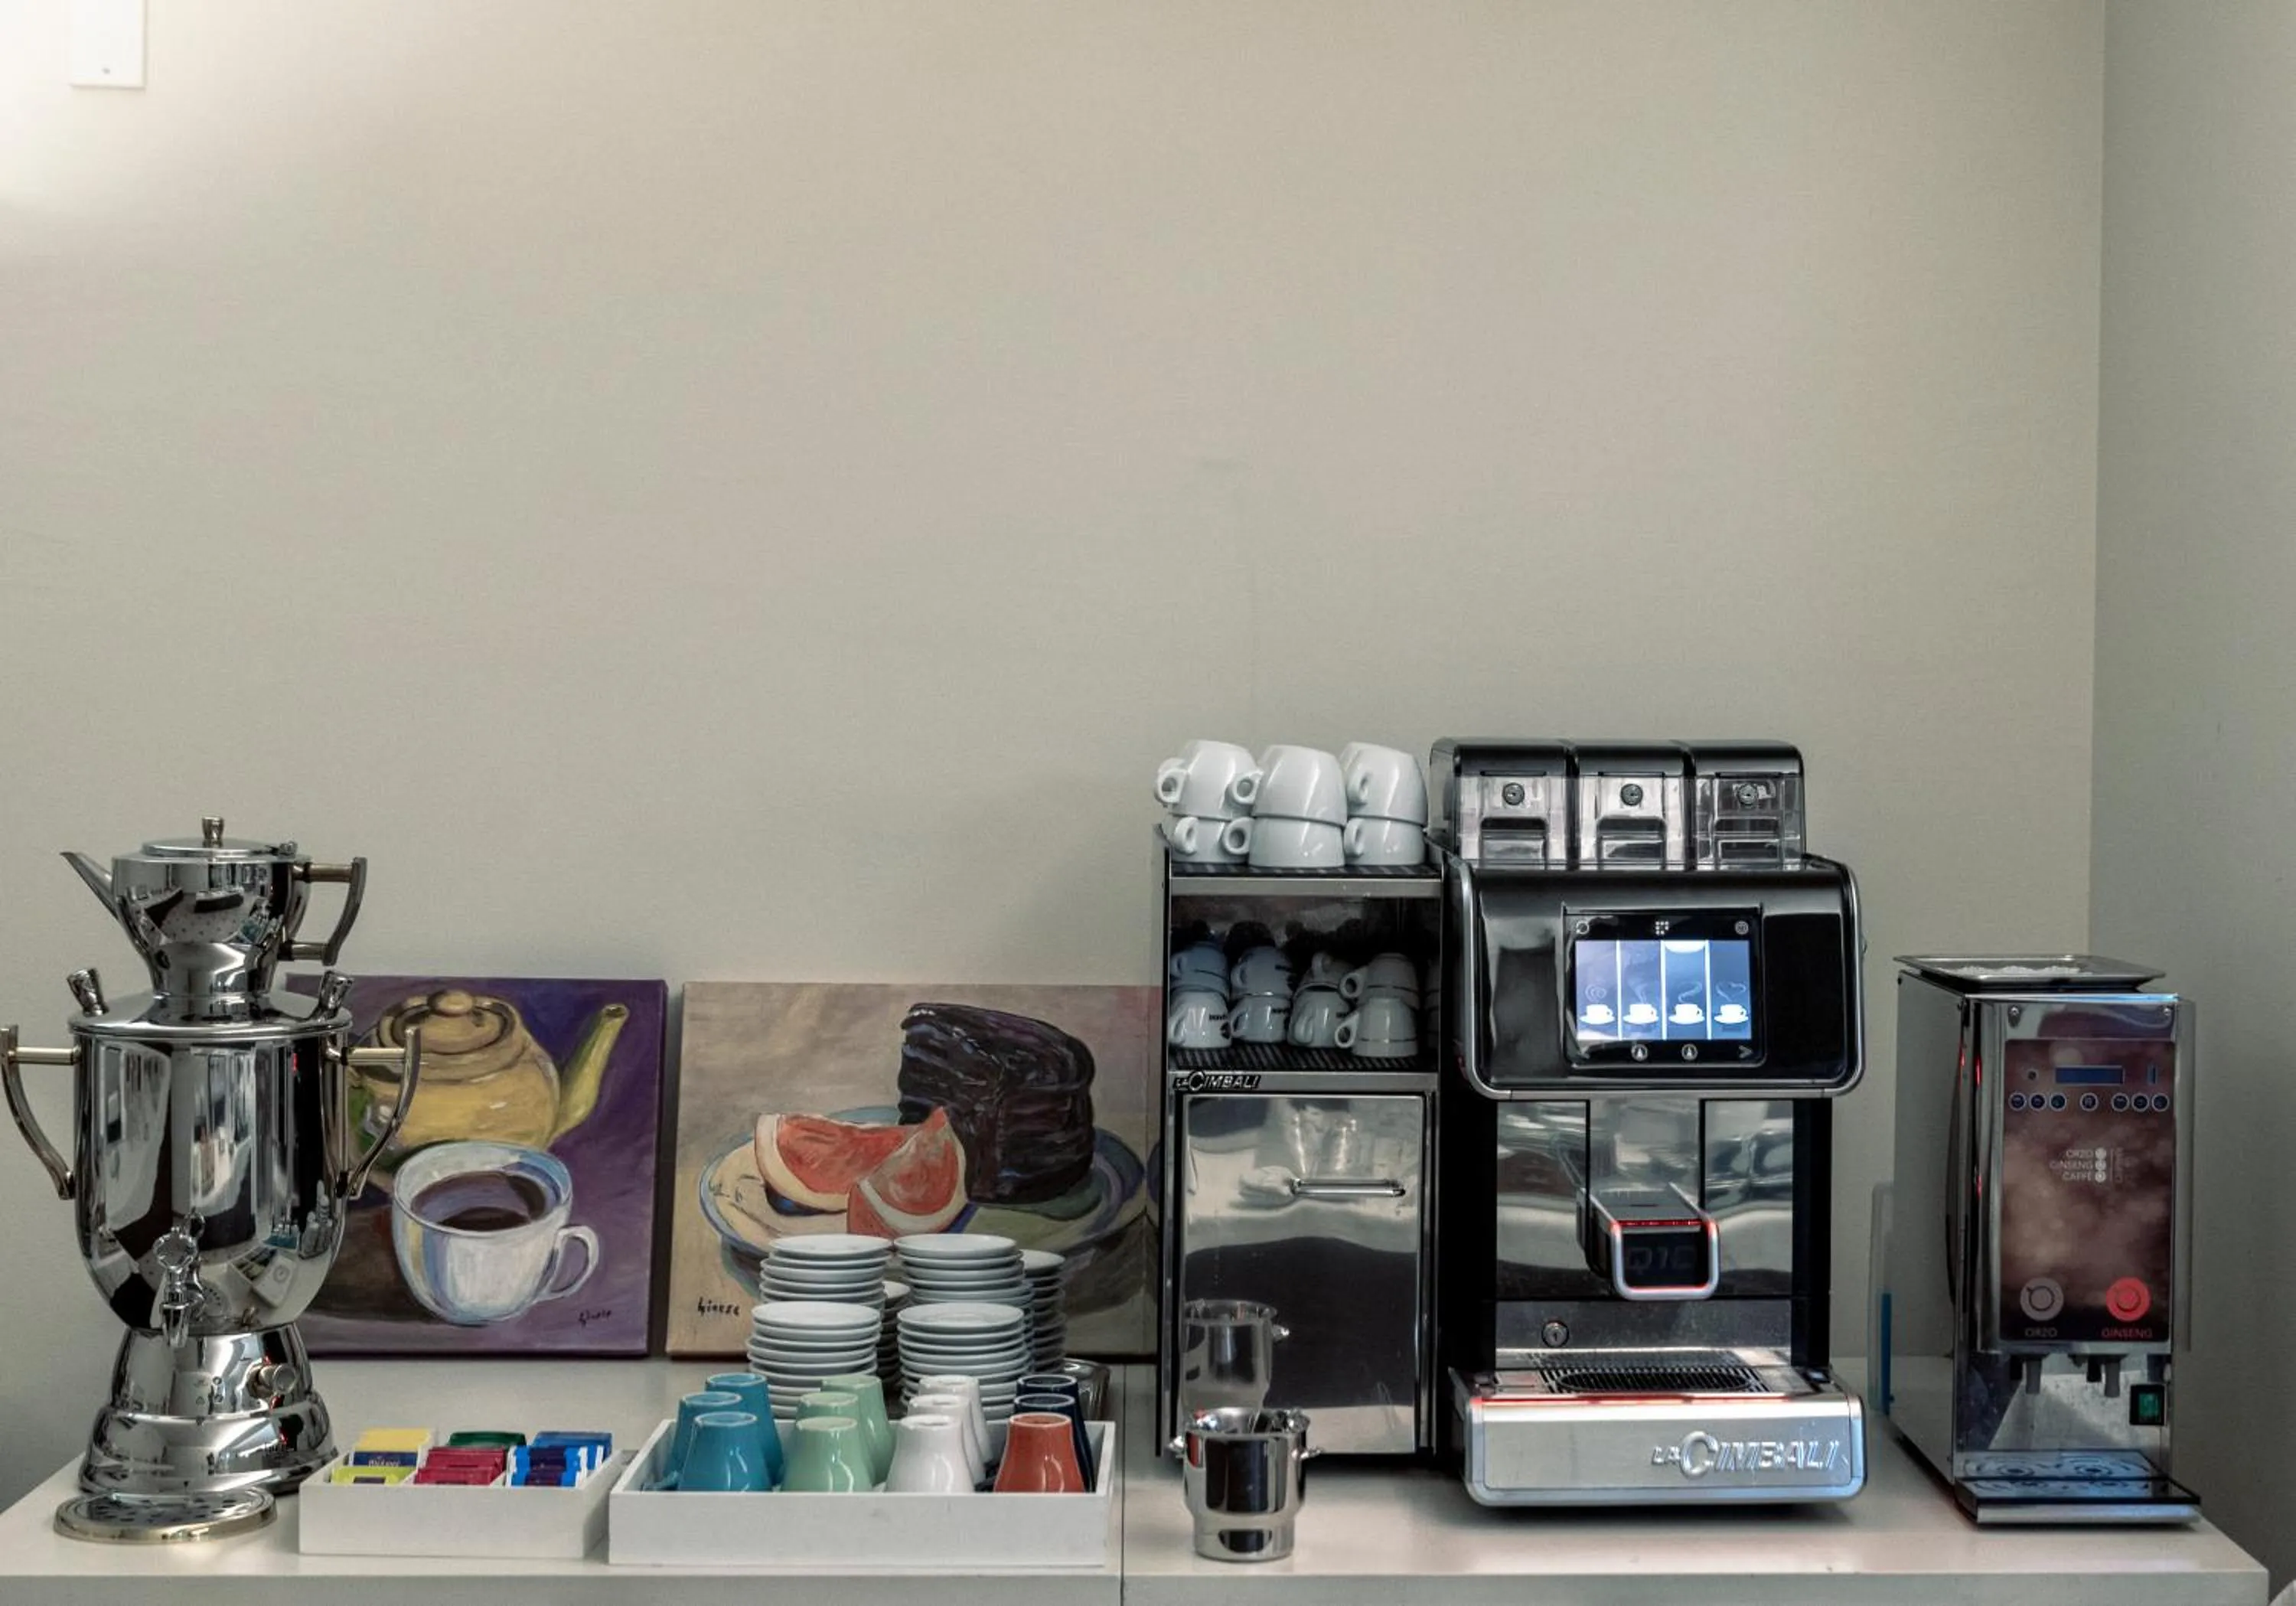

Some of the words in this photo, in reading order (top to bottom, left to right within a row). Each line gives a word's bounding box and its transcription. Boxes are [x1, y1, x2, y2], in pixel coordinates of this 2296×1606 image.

[1188, 1071, 1261, 1091] CIMBALI
[2024, 1327, 2058, 1337] ORZO
[2101, 1327, 2153, 1338] GINSENG
[1680, 1430, 1840, 1479] CIMBALI
